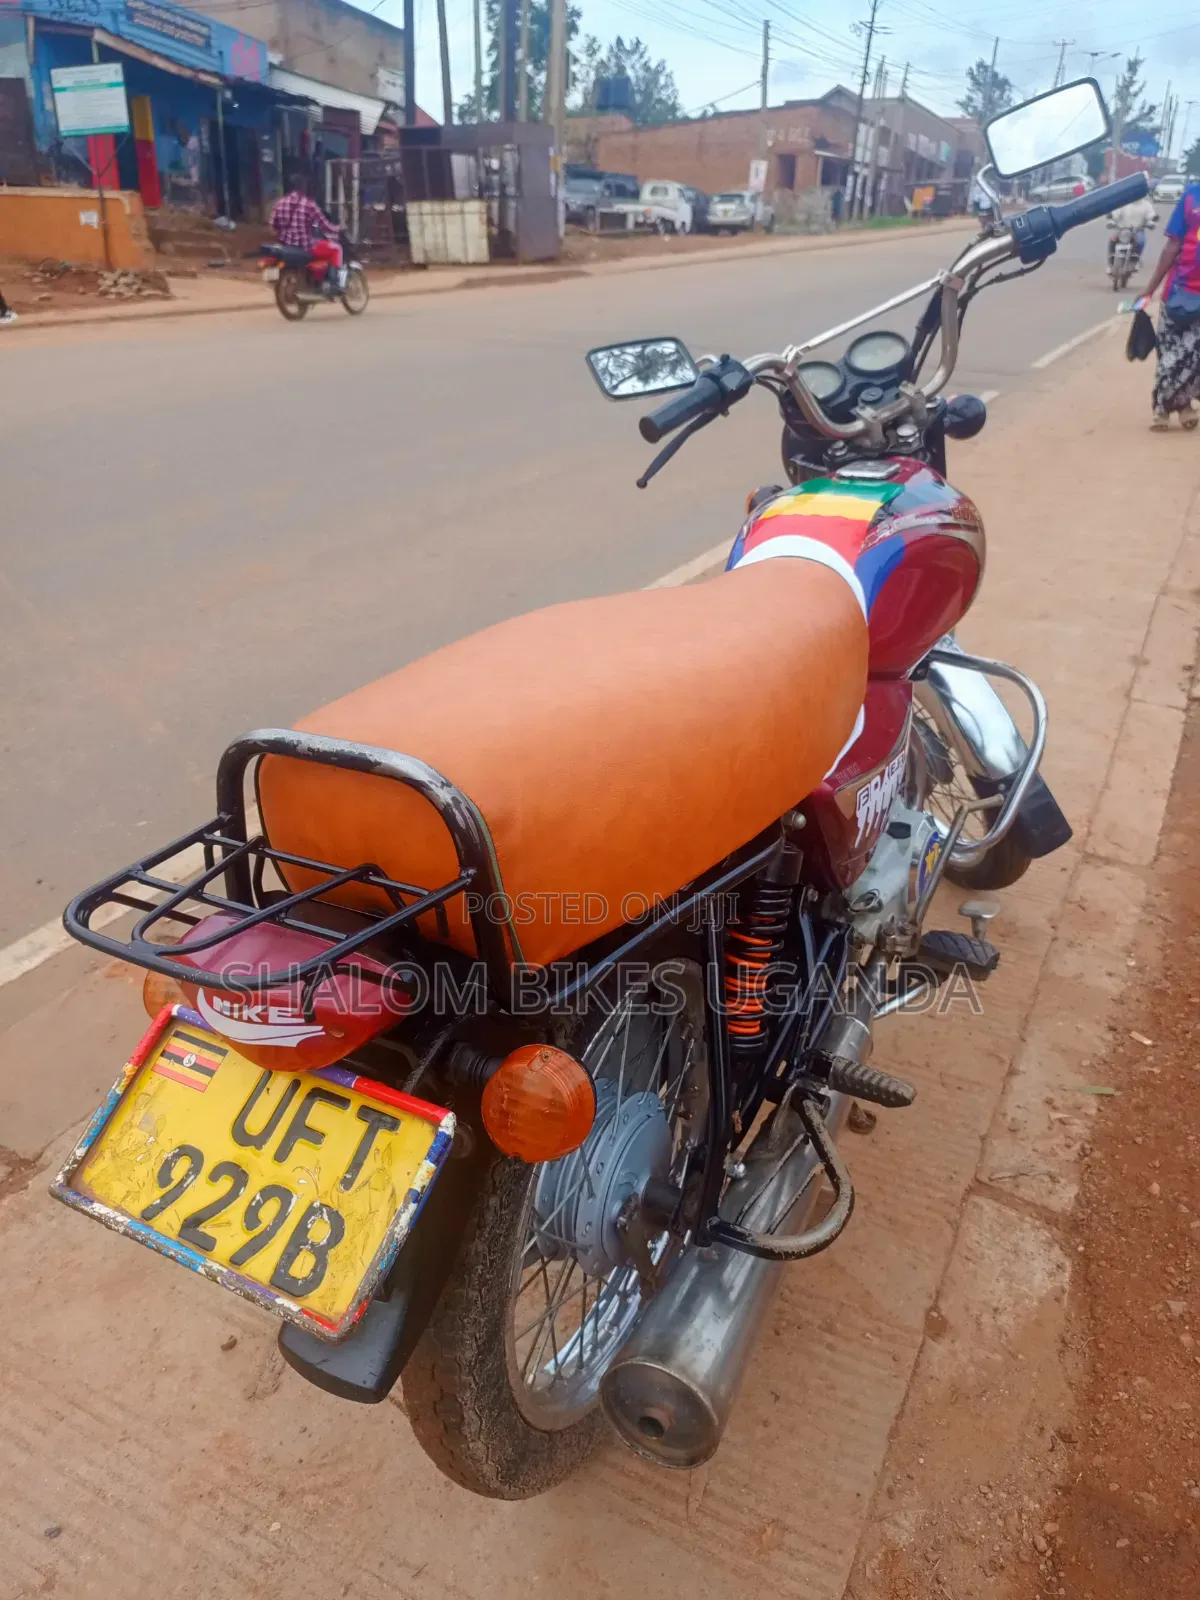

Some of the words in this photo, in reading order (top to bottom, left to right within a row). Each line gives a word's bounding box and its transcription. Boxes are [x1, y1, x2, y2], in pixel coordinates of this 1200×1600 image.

[213, 996, 305, 1024] NIKE
[231, 1070, 402, 1192] UFT
[140, 1144, 346, 1298] 929B
